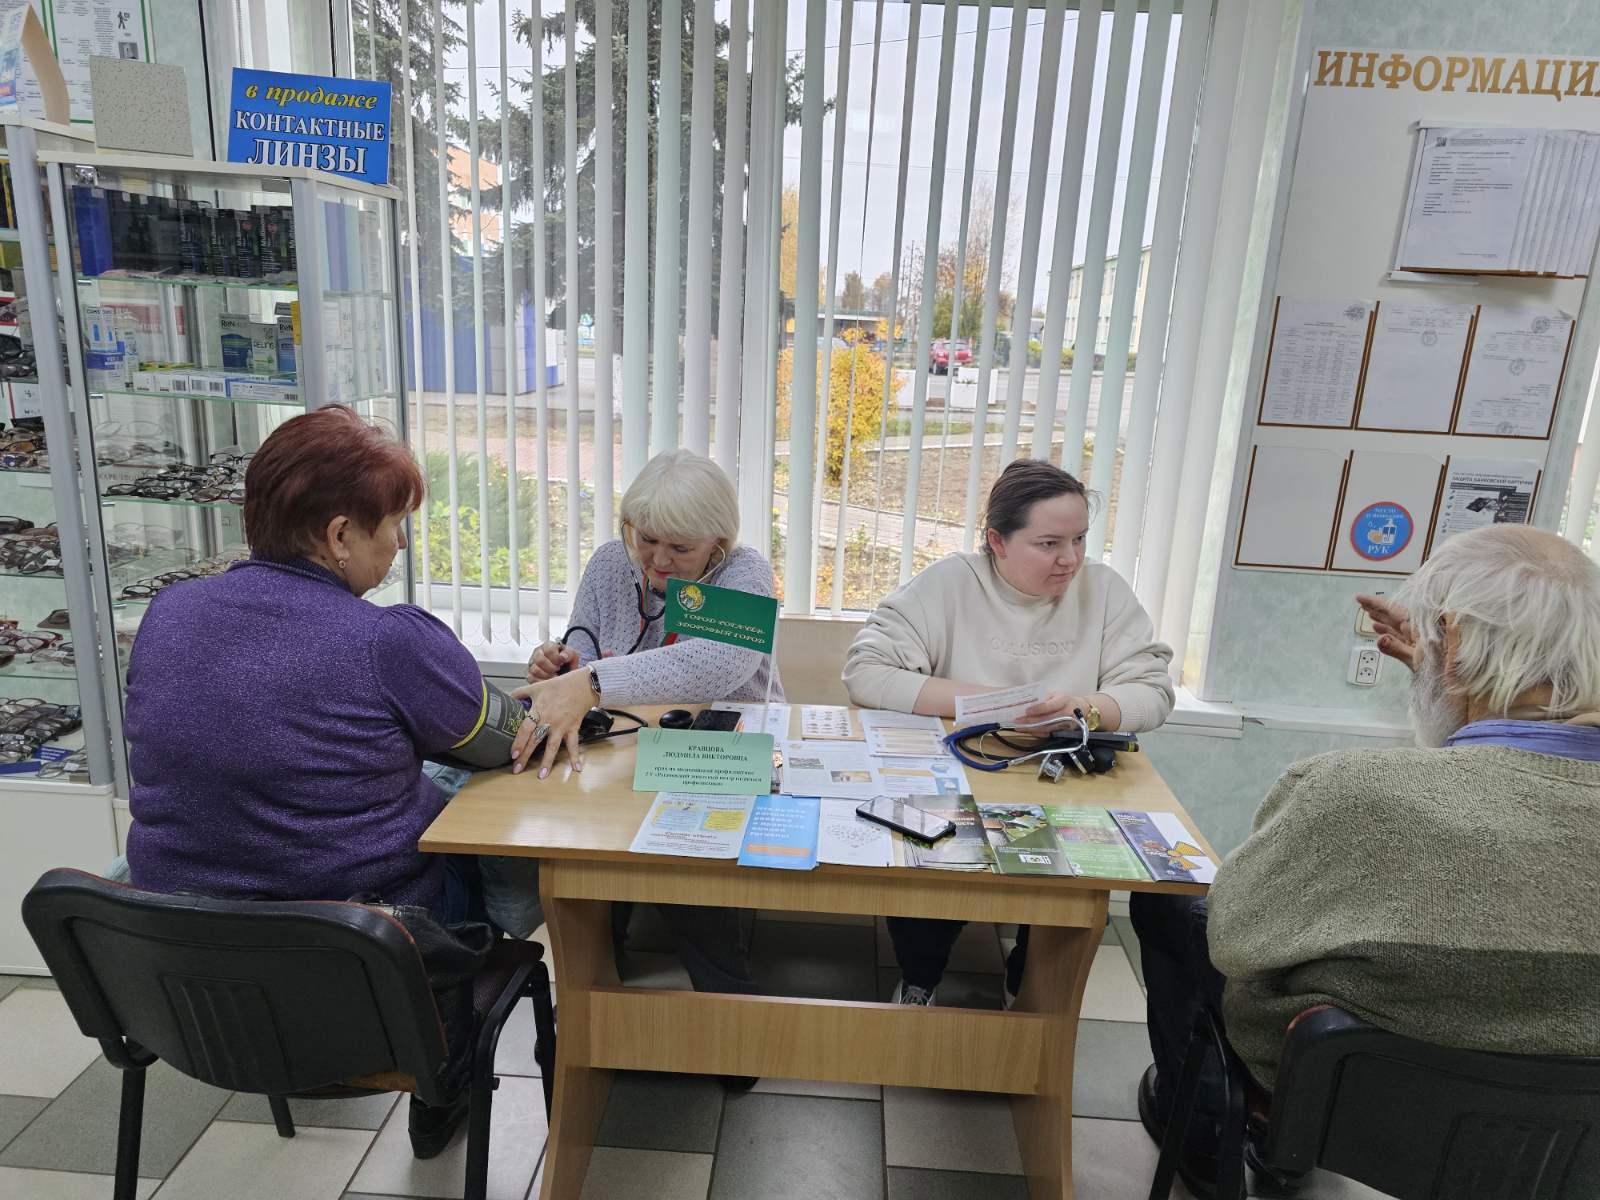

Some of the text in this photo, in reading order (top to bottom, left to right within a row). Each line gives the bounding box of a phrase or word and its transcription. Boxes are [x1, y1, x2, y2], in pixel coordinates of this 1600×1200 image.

[1313, 50, 1600, 102] ИНФОРМАЦИ
[245, 84, 380, 111] в продаже
[234, 110, 386, 142] КОНТАКТНЫЕ
[247, 139, 368, 174] ЛИНЗЫ
[663, 751, 749, 761] ЛЮДМИЛА ВИКТОРОВНА
